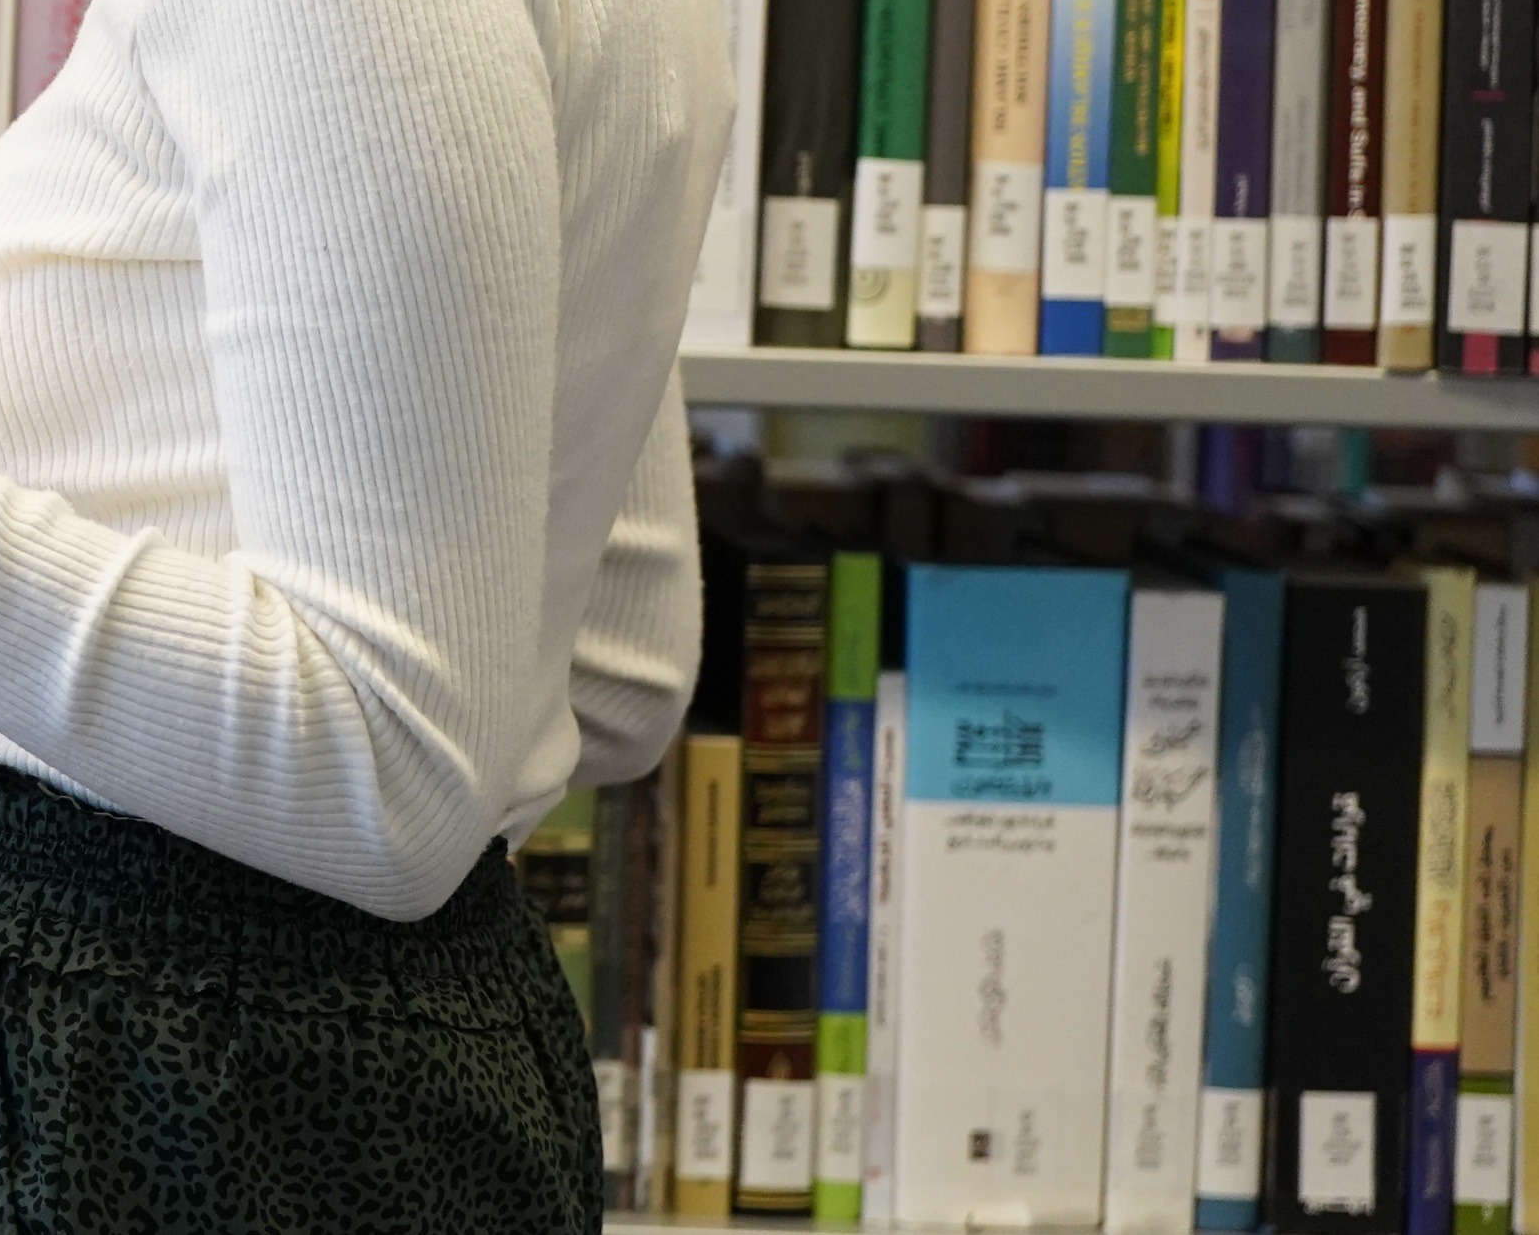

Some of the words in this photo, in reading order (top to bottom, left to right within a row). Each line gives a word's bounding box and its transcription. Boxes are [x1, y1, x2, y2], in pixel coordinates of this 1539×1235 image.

[1350, 85, 1368, 125] and
[1348, 127, 1370, 183] Sufis
[1329, 870, 1373, 916] في
[1321, 915, 1362, 994] القرآن
